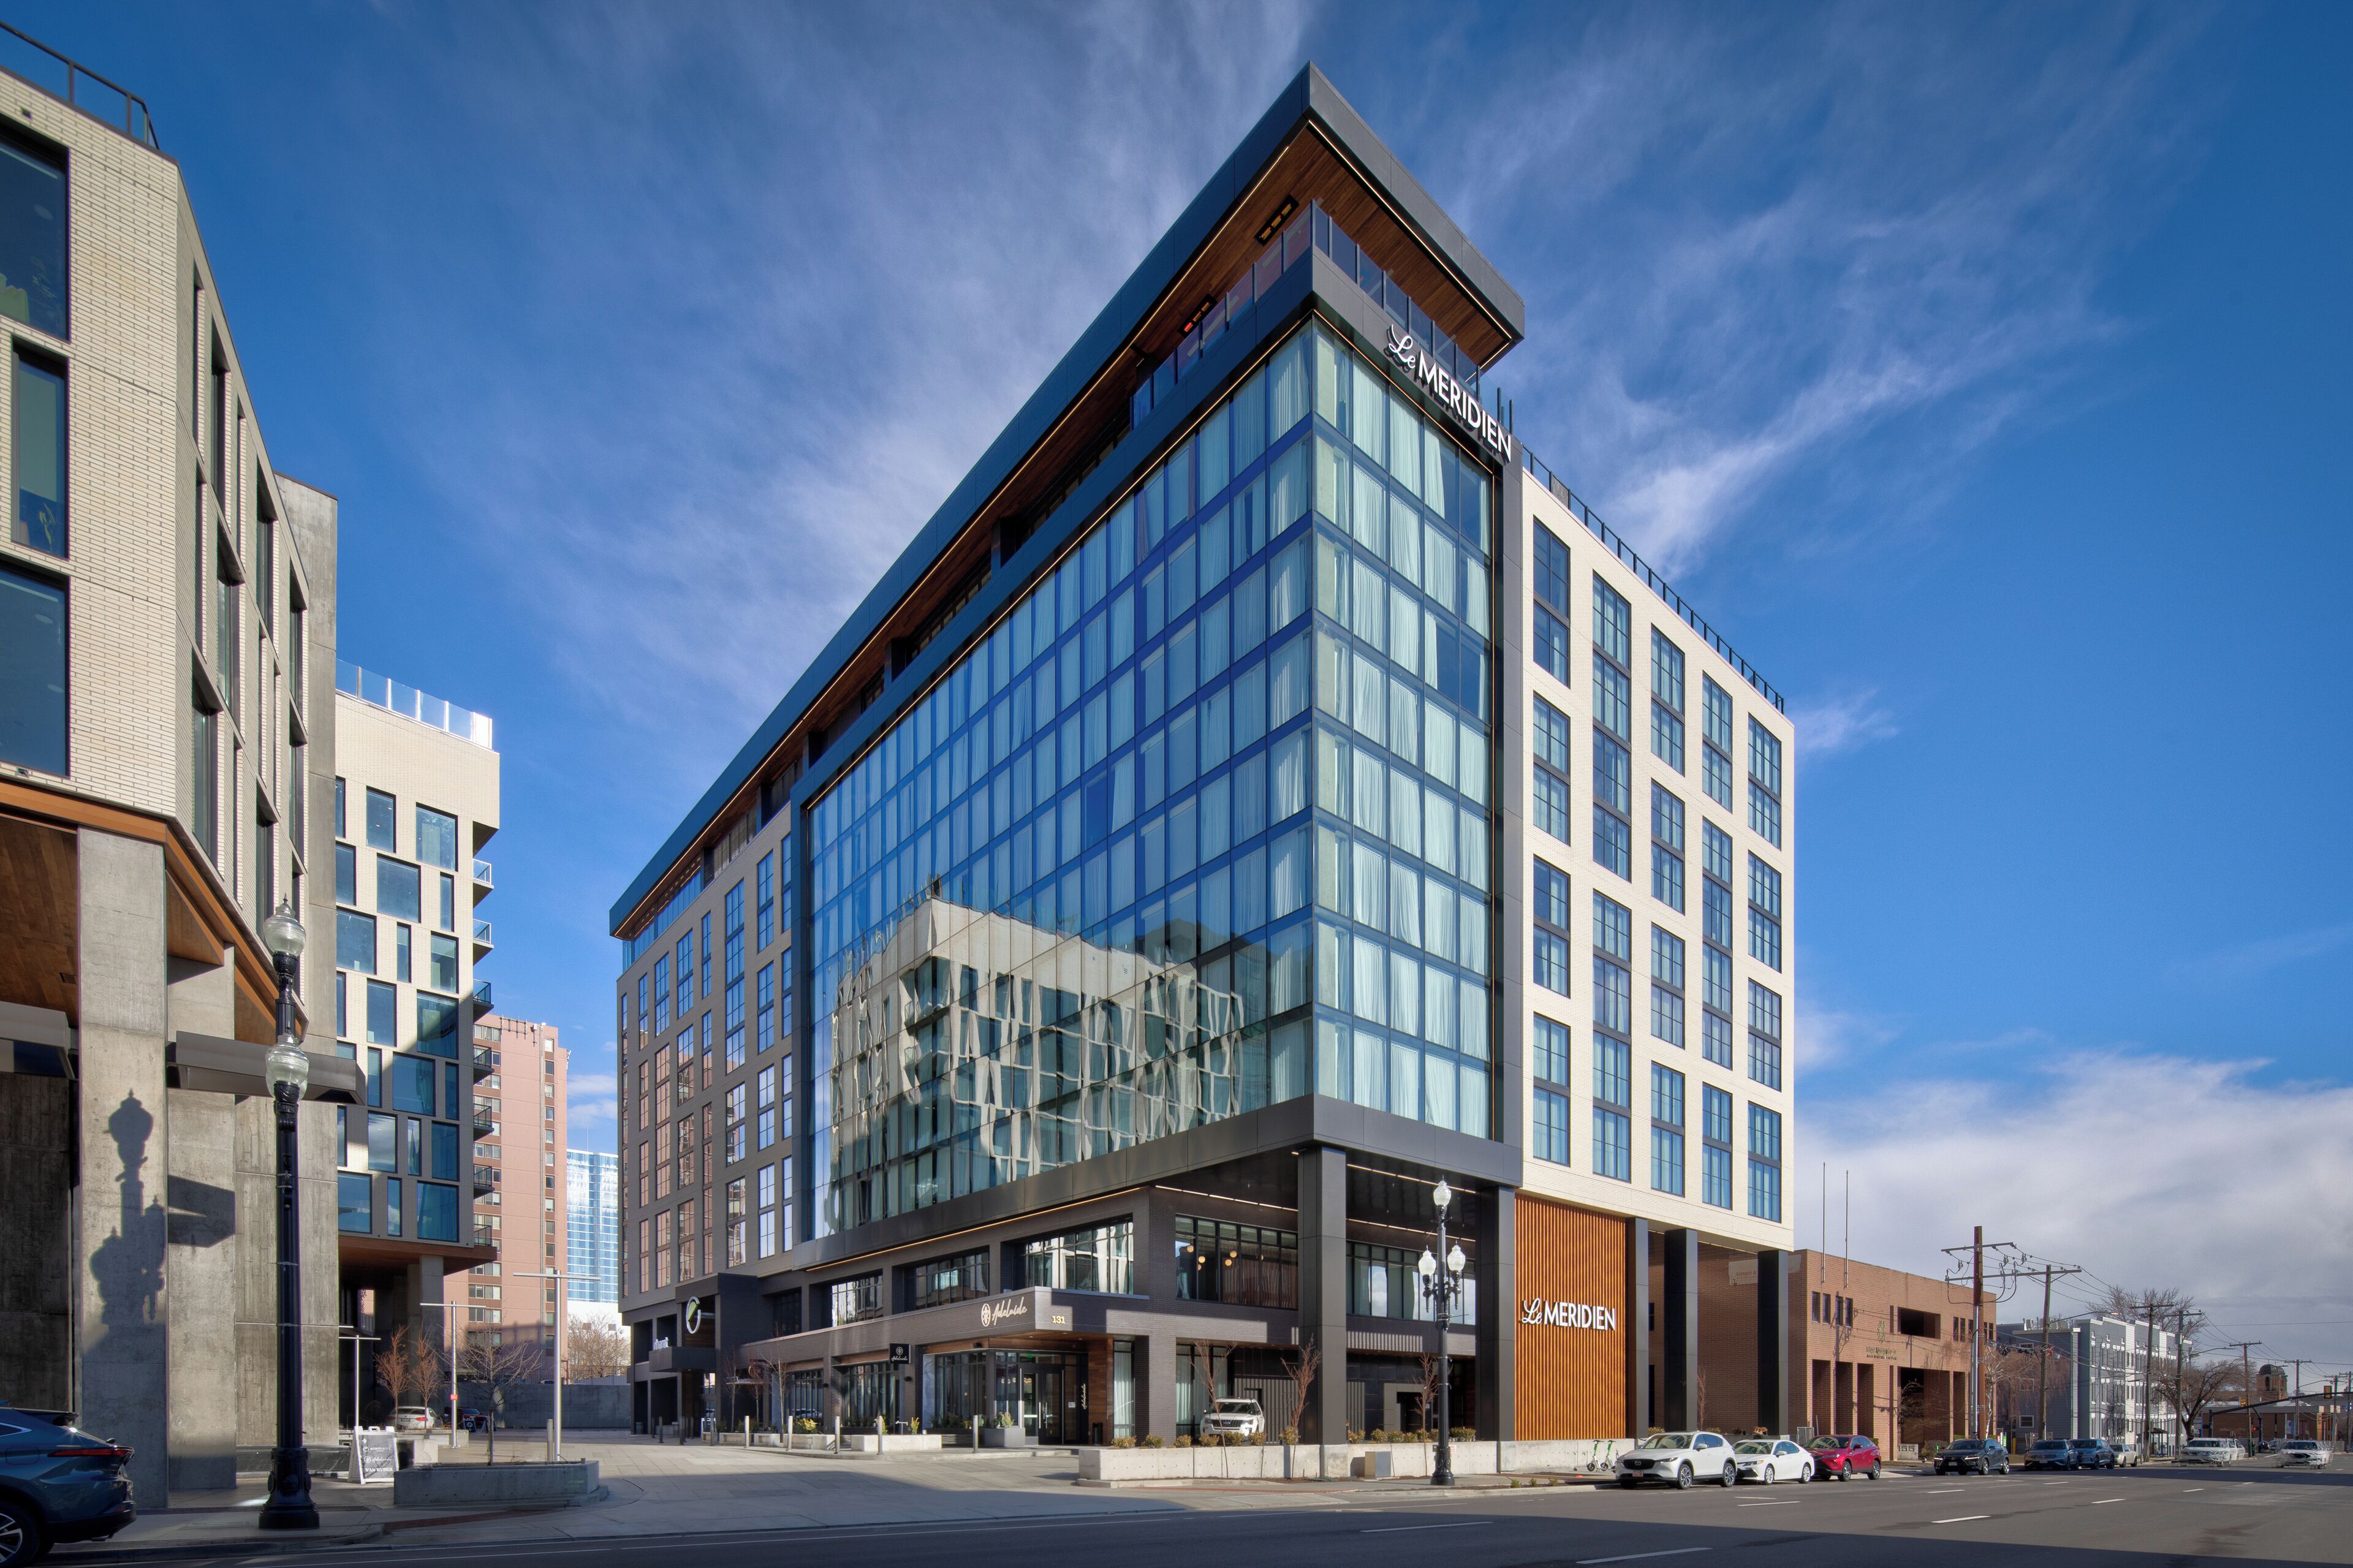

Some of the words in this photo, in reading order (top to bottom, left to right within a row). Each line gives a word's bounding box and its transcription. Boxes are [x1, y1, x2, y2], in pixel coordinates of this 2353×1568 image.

[1387, 324, 1416, 370] Le
[1418, 349, 1512, 463] MERIDIEN
[991, 1296, 1028, 1325] Adelaide
[1051, 1316, 1066, 1324] 131
[1521, 1298, 1542, 1324] Le
[1544, 1300, 1615, 1331] MERIDIEN
